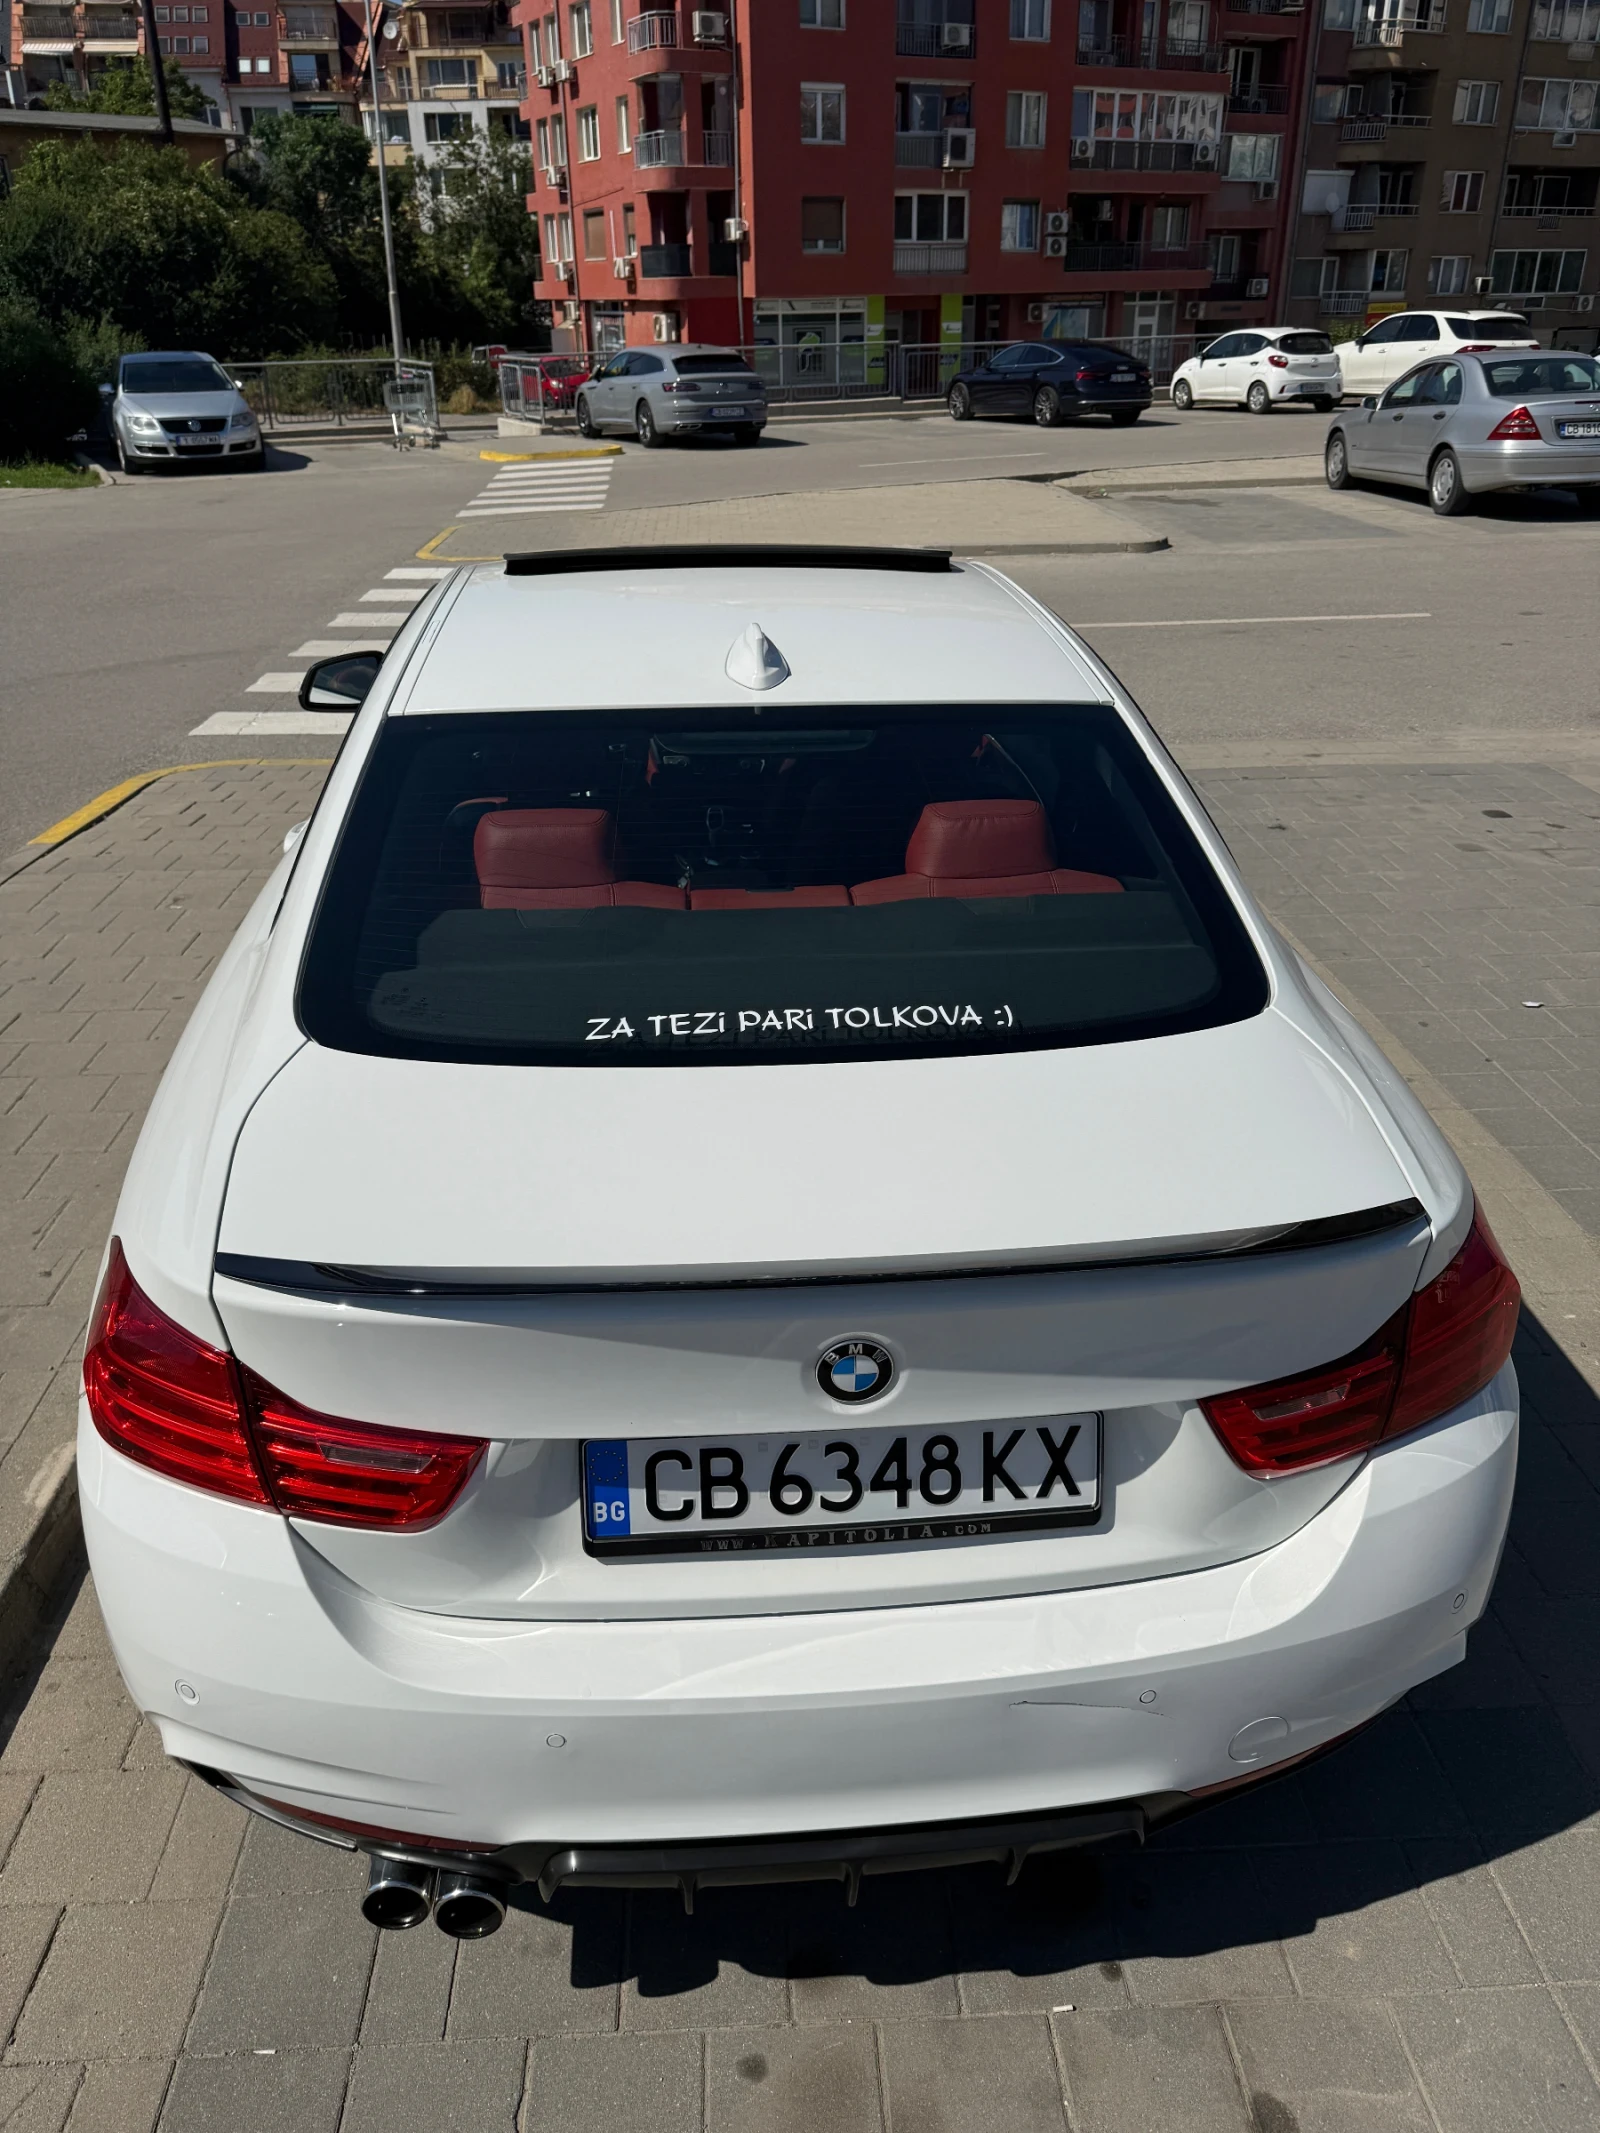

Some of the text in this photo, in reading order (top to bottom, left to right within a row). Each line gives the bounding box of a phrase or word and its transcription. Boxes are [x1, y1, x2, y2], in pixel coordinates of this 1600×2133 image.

[1566, 423, 1579, 435] CB
[585, 1004, 1013, 1040] ZA TEZi PARi TOLKOVA :)
[824, 1343, 888, 1366] BMW
[644, 1425, 1081, 1521] CB 6348 KX
[593, 1500, 626, 1523] BG
